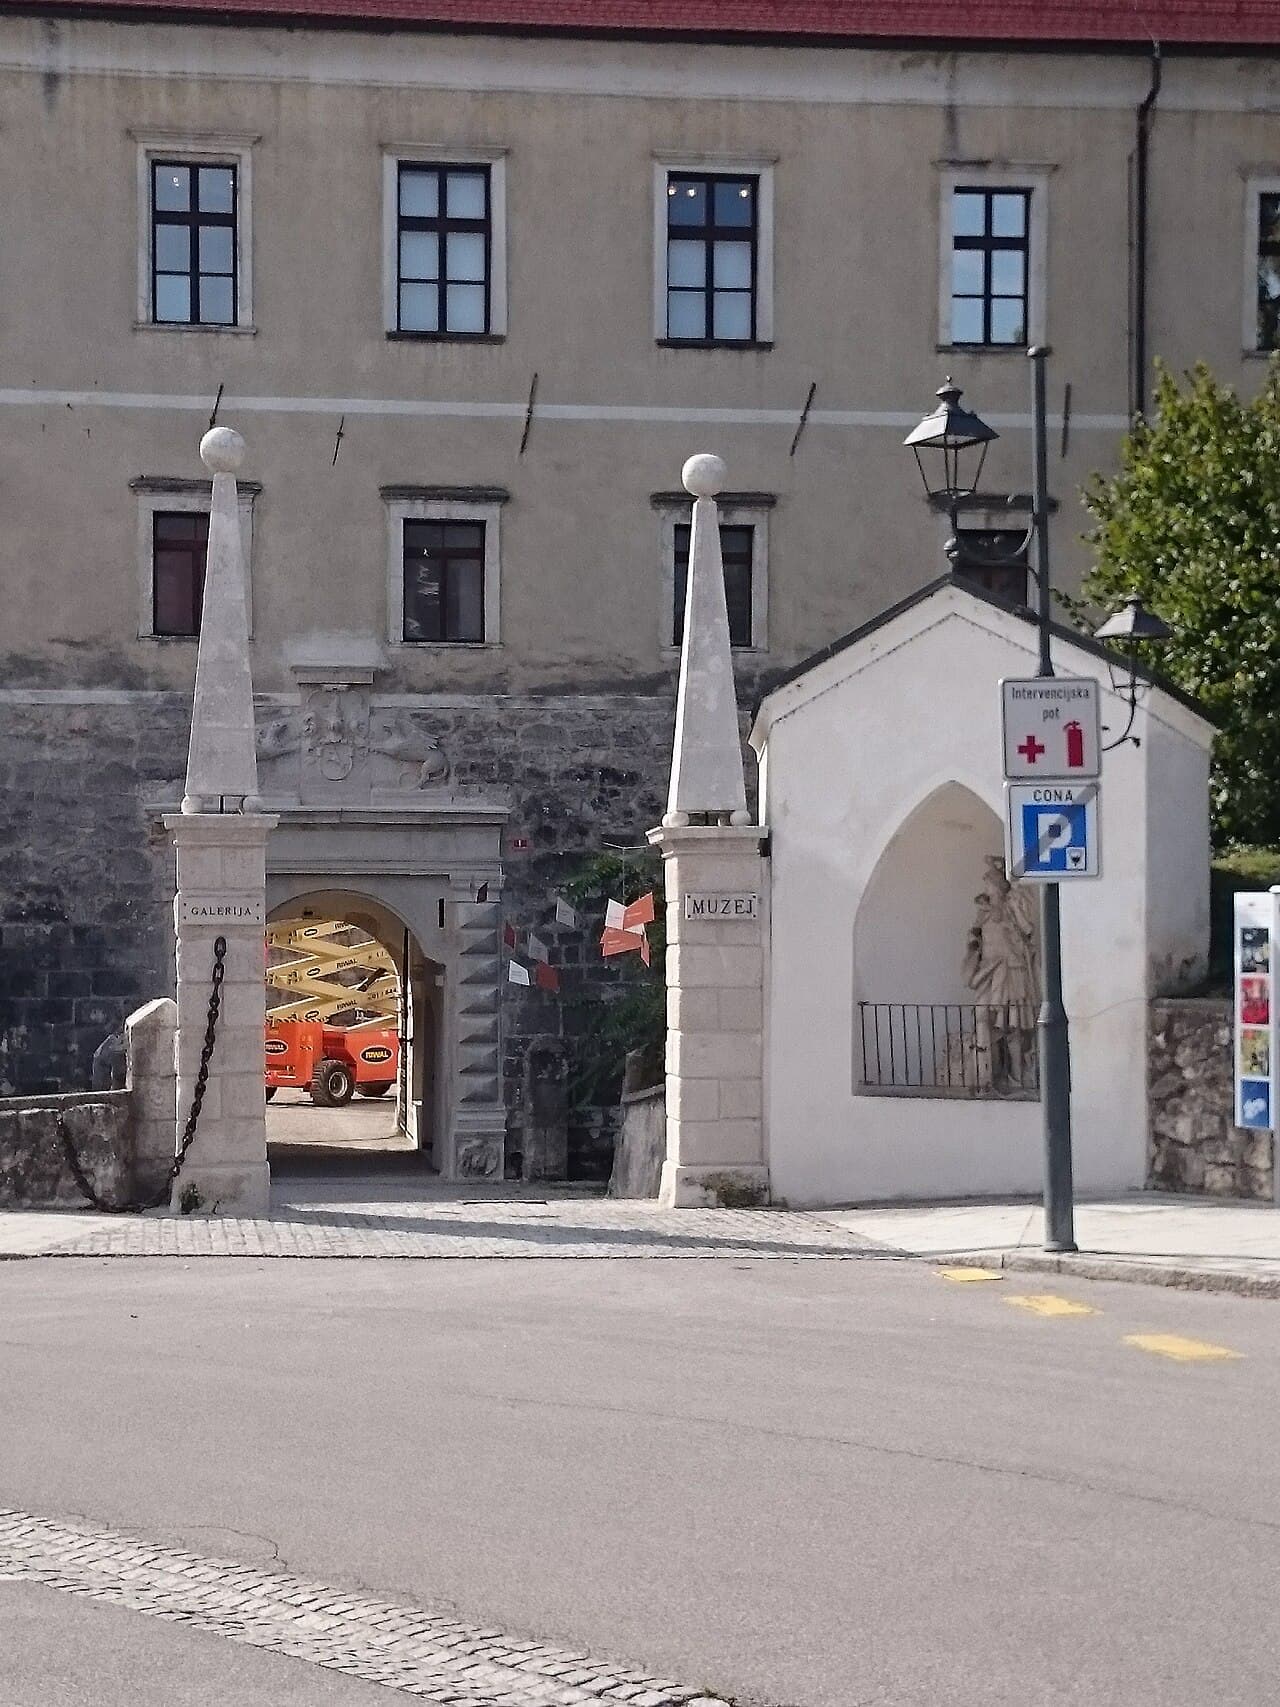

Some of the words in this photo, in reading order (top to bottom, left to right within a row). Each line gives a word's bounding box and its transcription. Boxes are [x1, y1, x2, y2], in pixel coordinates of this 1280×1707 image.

[1012, 687, 1089, 701] Intervencijska
[1043, 707, 1060, 722] pot
[1033, 789, 1073, 802] CONA
[191, 906, 252, 917] GALERIJA
[692, 899, 754, 915] MUZEJ
[365, 1050, 389, 1059] RIWAL
